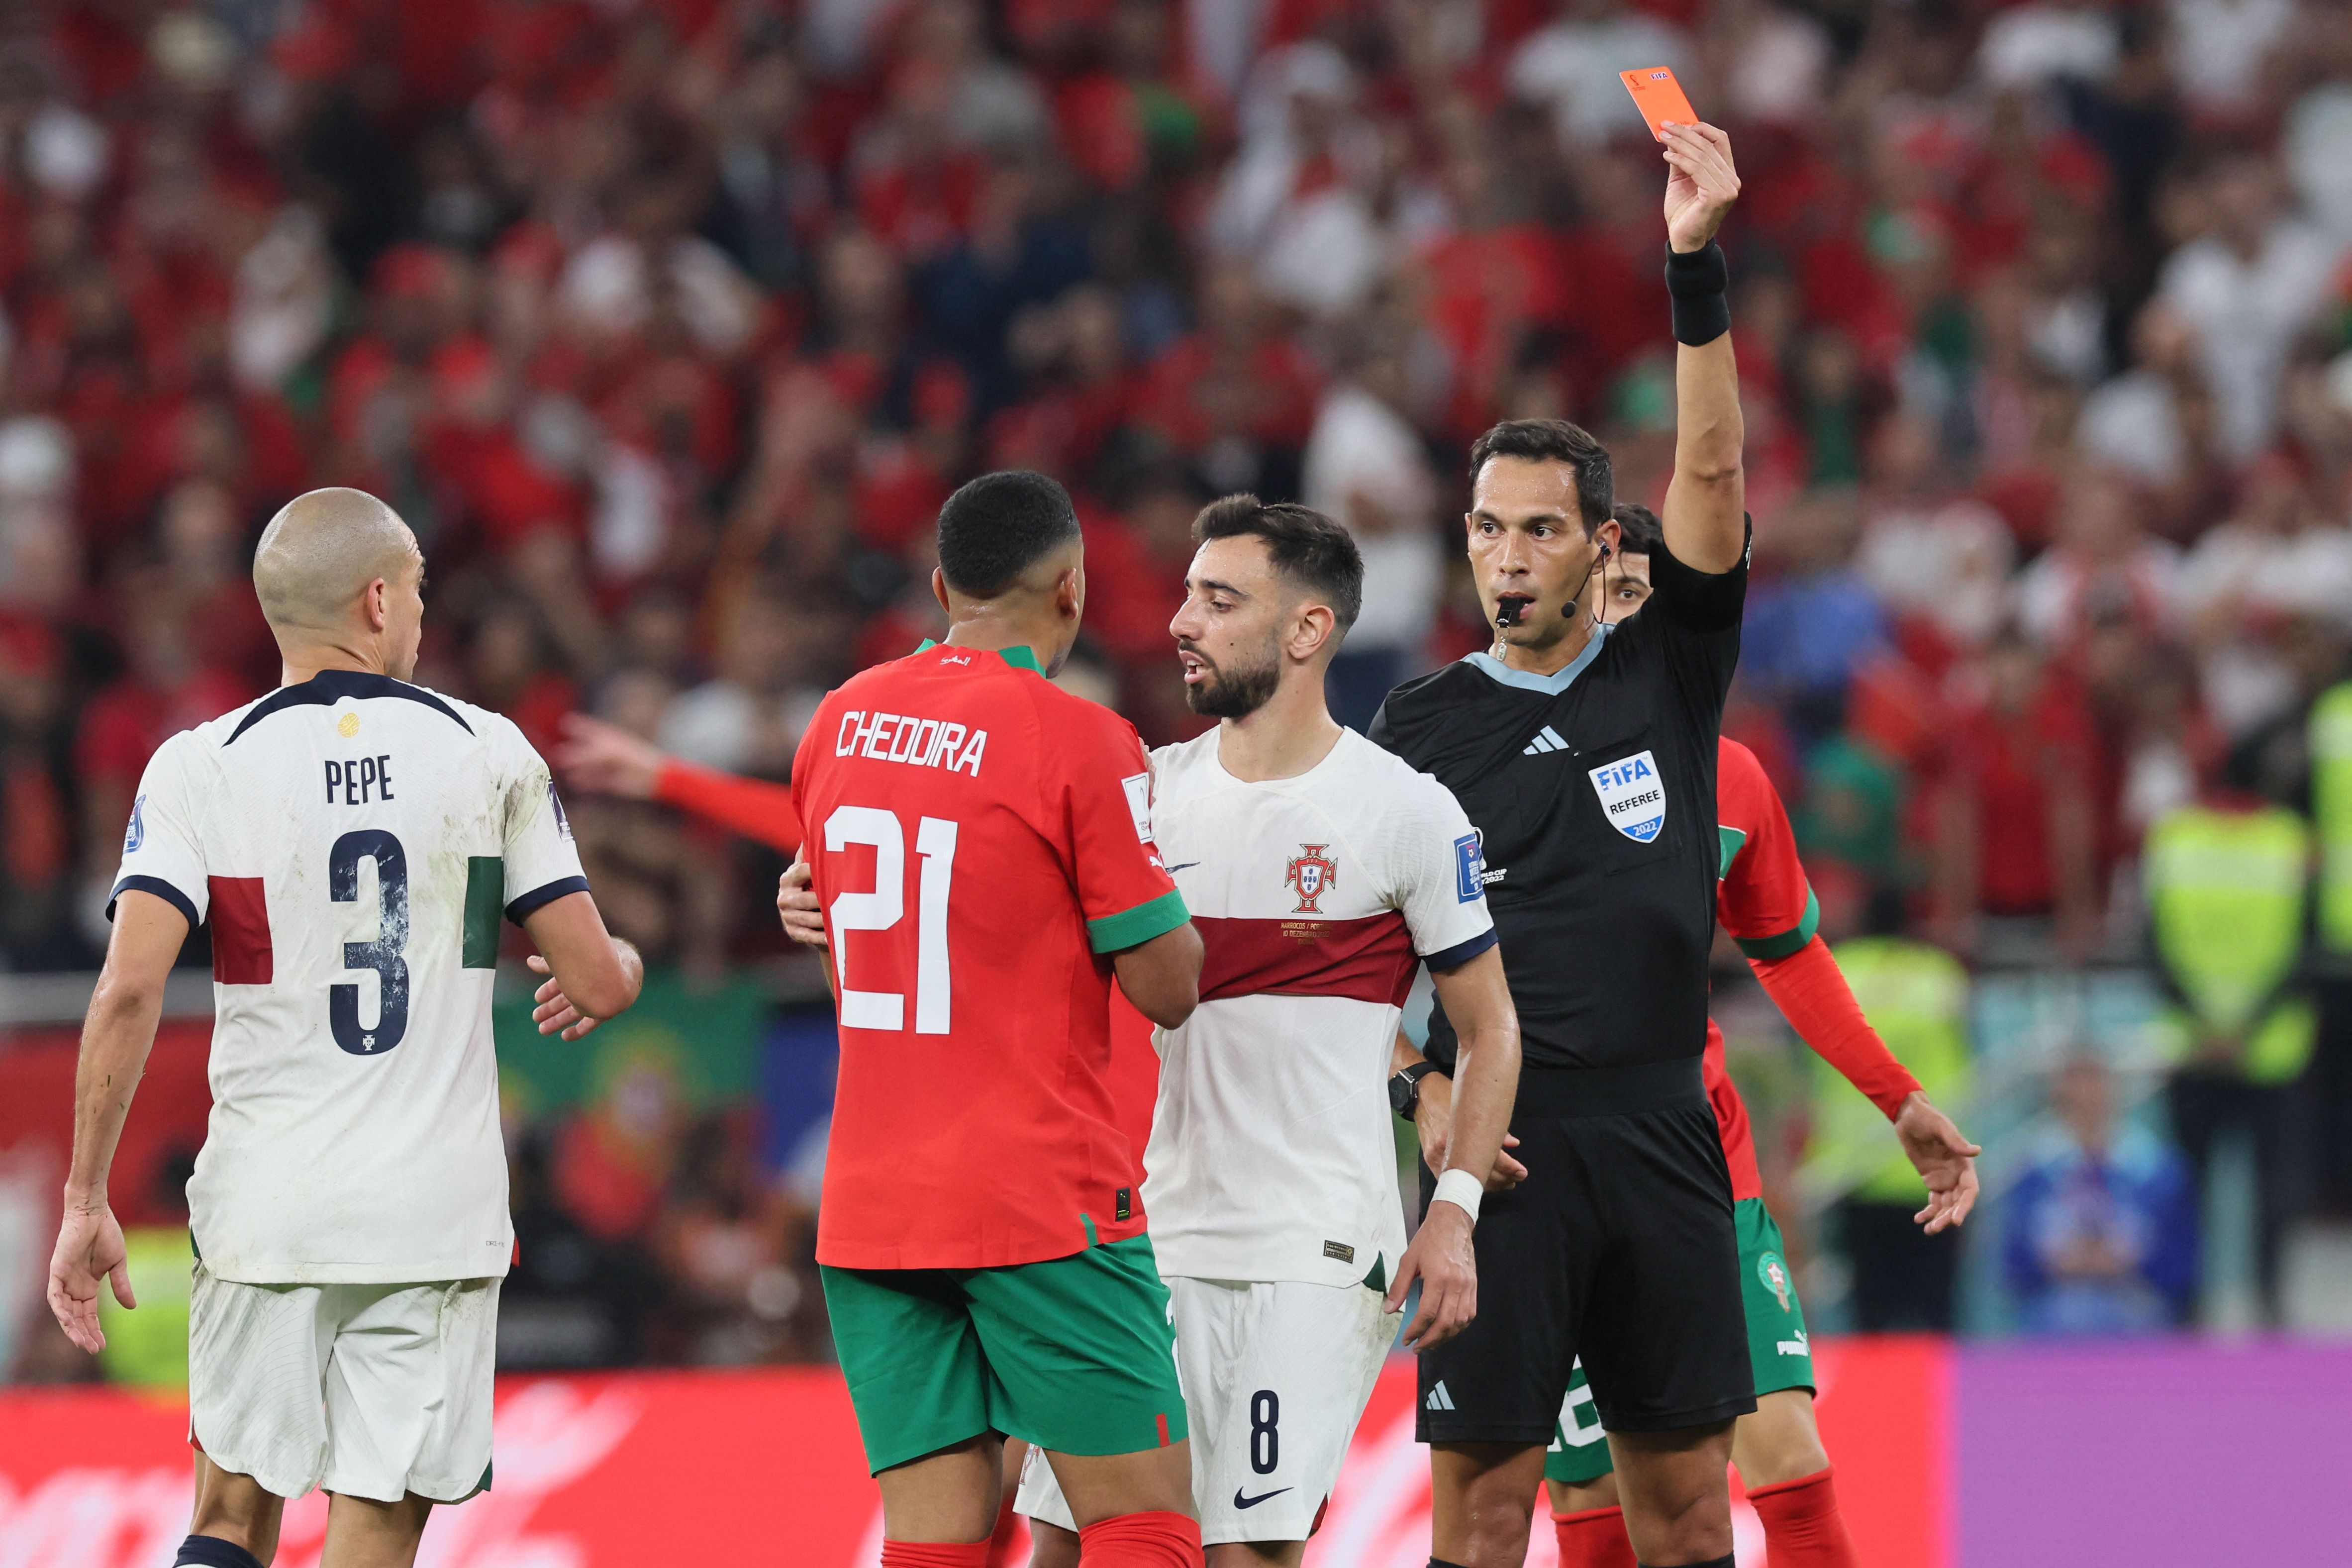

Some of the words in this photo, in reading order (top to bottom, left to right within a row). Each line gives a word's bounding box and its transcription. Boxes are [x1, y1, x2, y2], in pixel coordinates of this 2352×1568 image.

[835, 710, 987, 778] CHEDDIRA
[325, 755, 394, 805] PEPE
[1597, 759, 1652, 791] FIFA
[1610, 789, 1661, 815] REFEREE
[1633, 821, 1658, 836] 2022
[329, 829, 410, 1056] 3
[824, 805, 958, 1035] 21
[1250, 1390, 1279, 1474] 8
